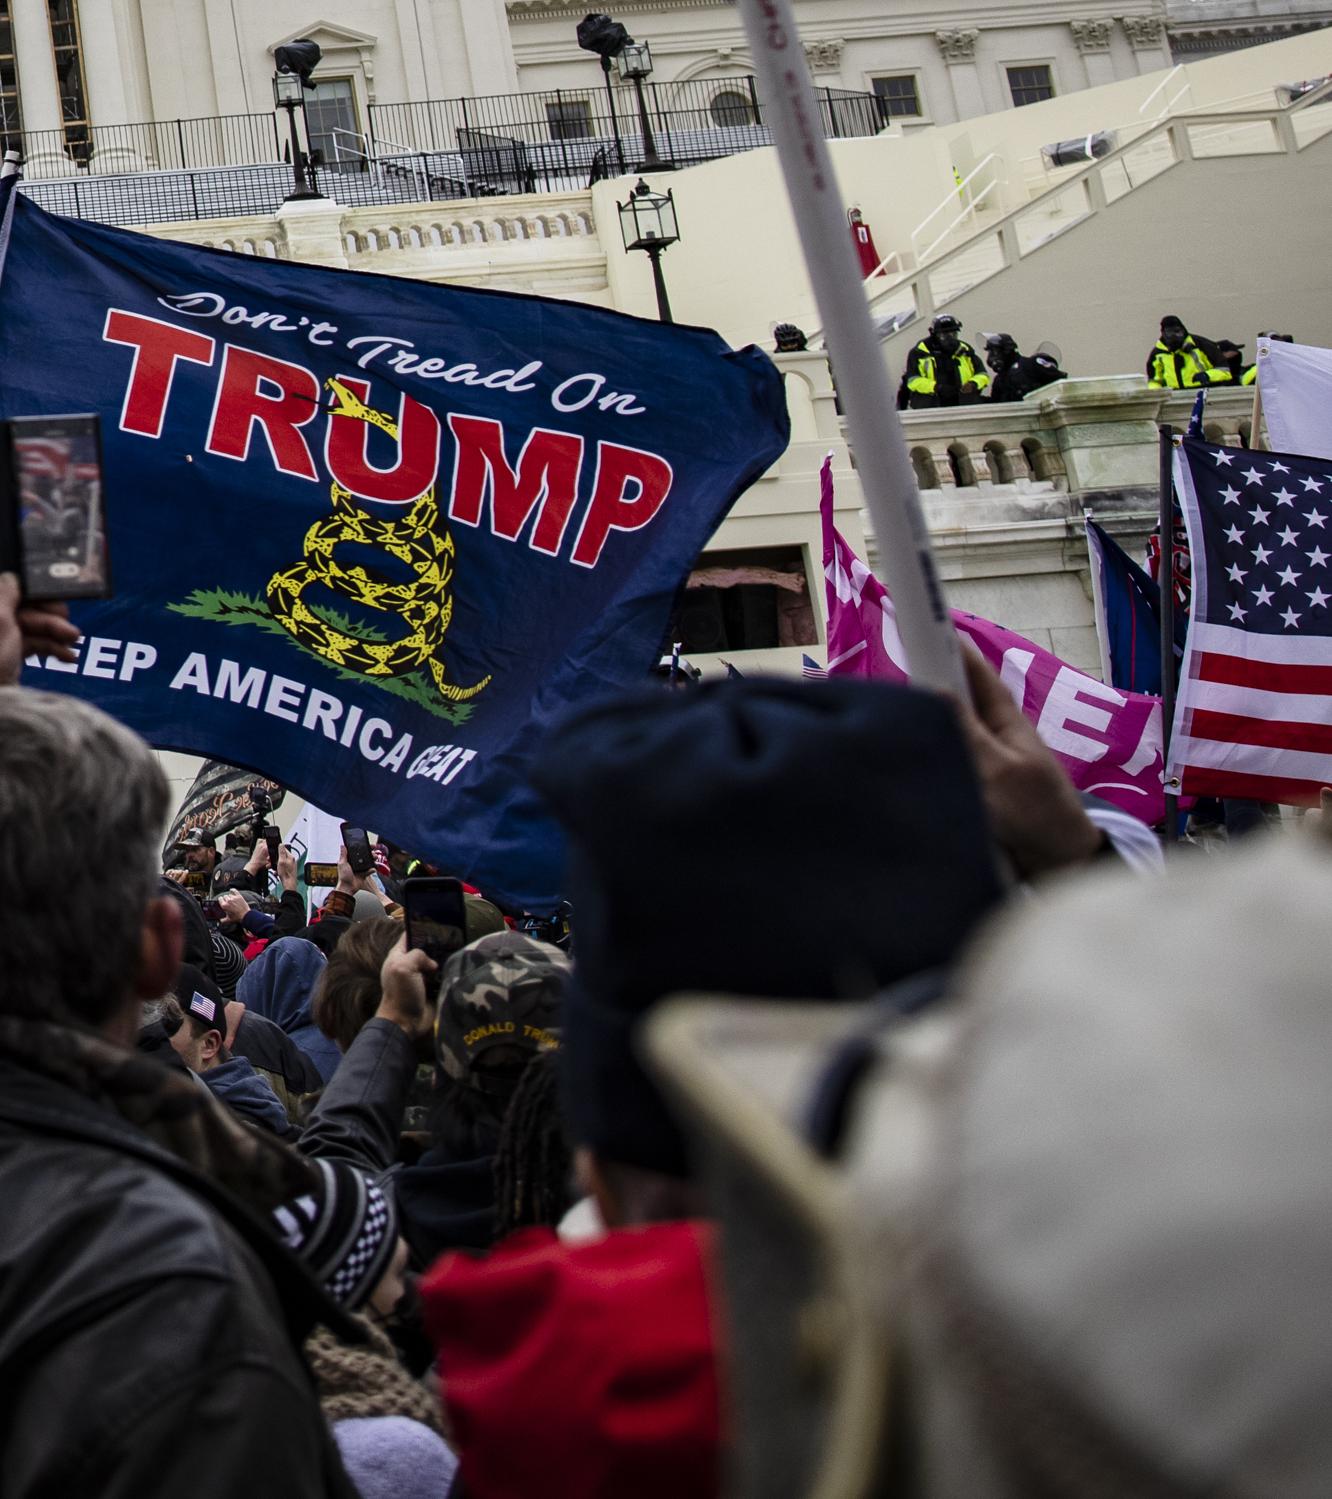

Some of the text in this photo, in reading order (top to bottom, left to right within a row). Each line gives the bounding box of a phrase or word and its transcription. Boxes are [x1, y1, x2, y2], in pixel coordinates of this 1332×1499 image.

[157, 290, 645, 415] Don't Tread On
[102, 307, 673, 568] TRUMP
[24, 635, 478, 786] EEP AMERICA GEAT
[463, 1021, 515, 1046] DONALD
